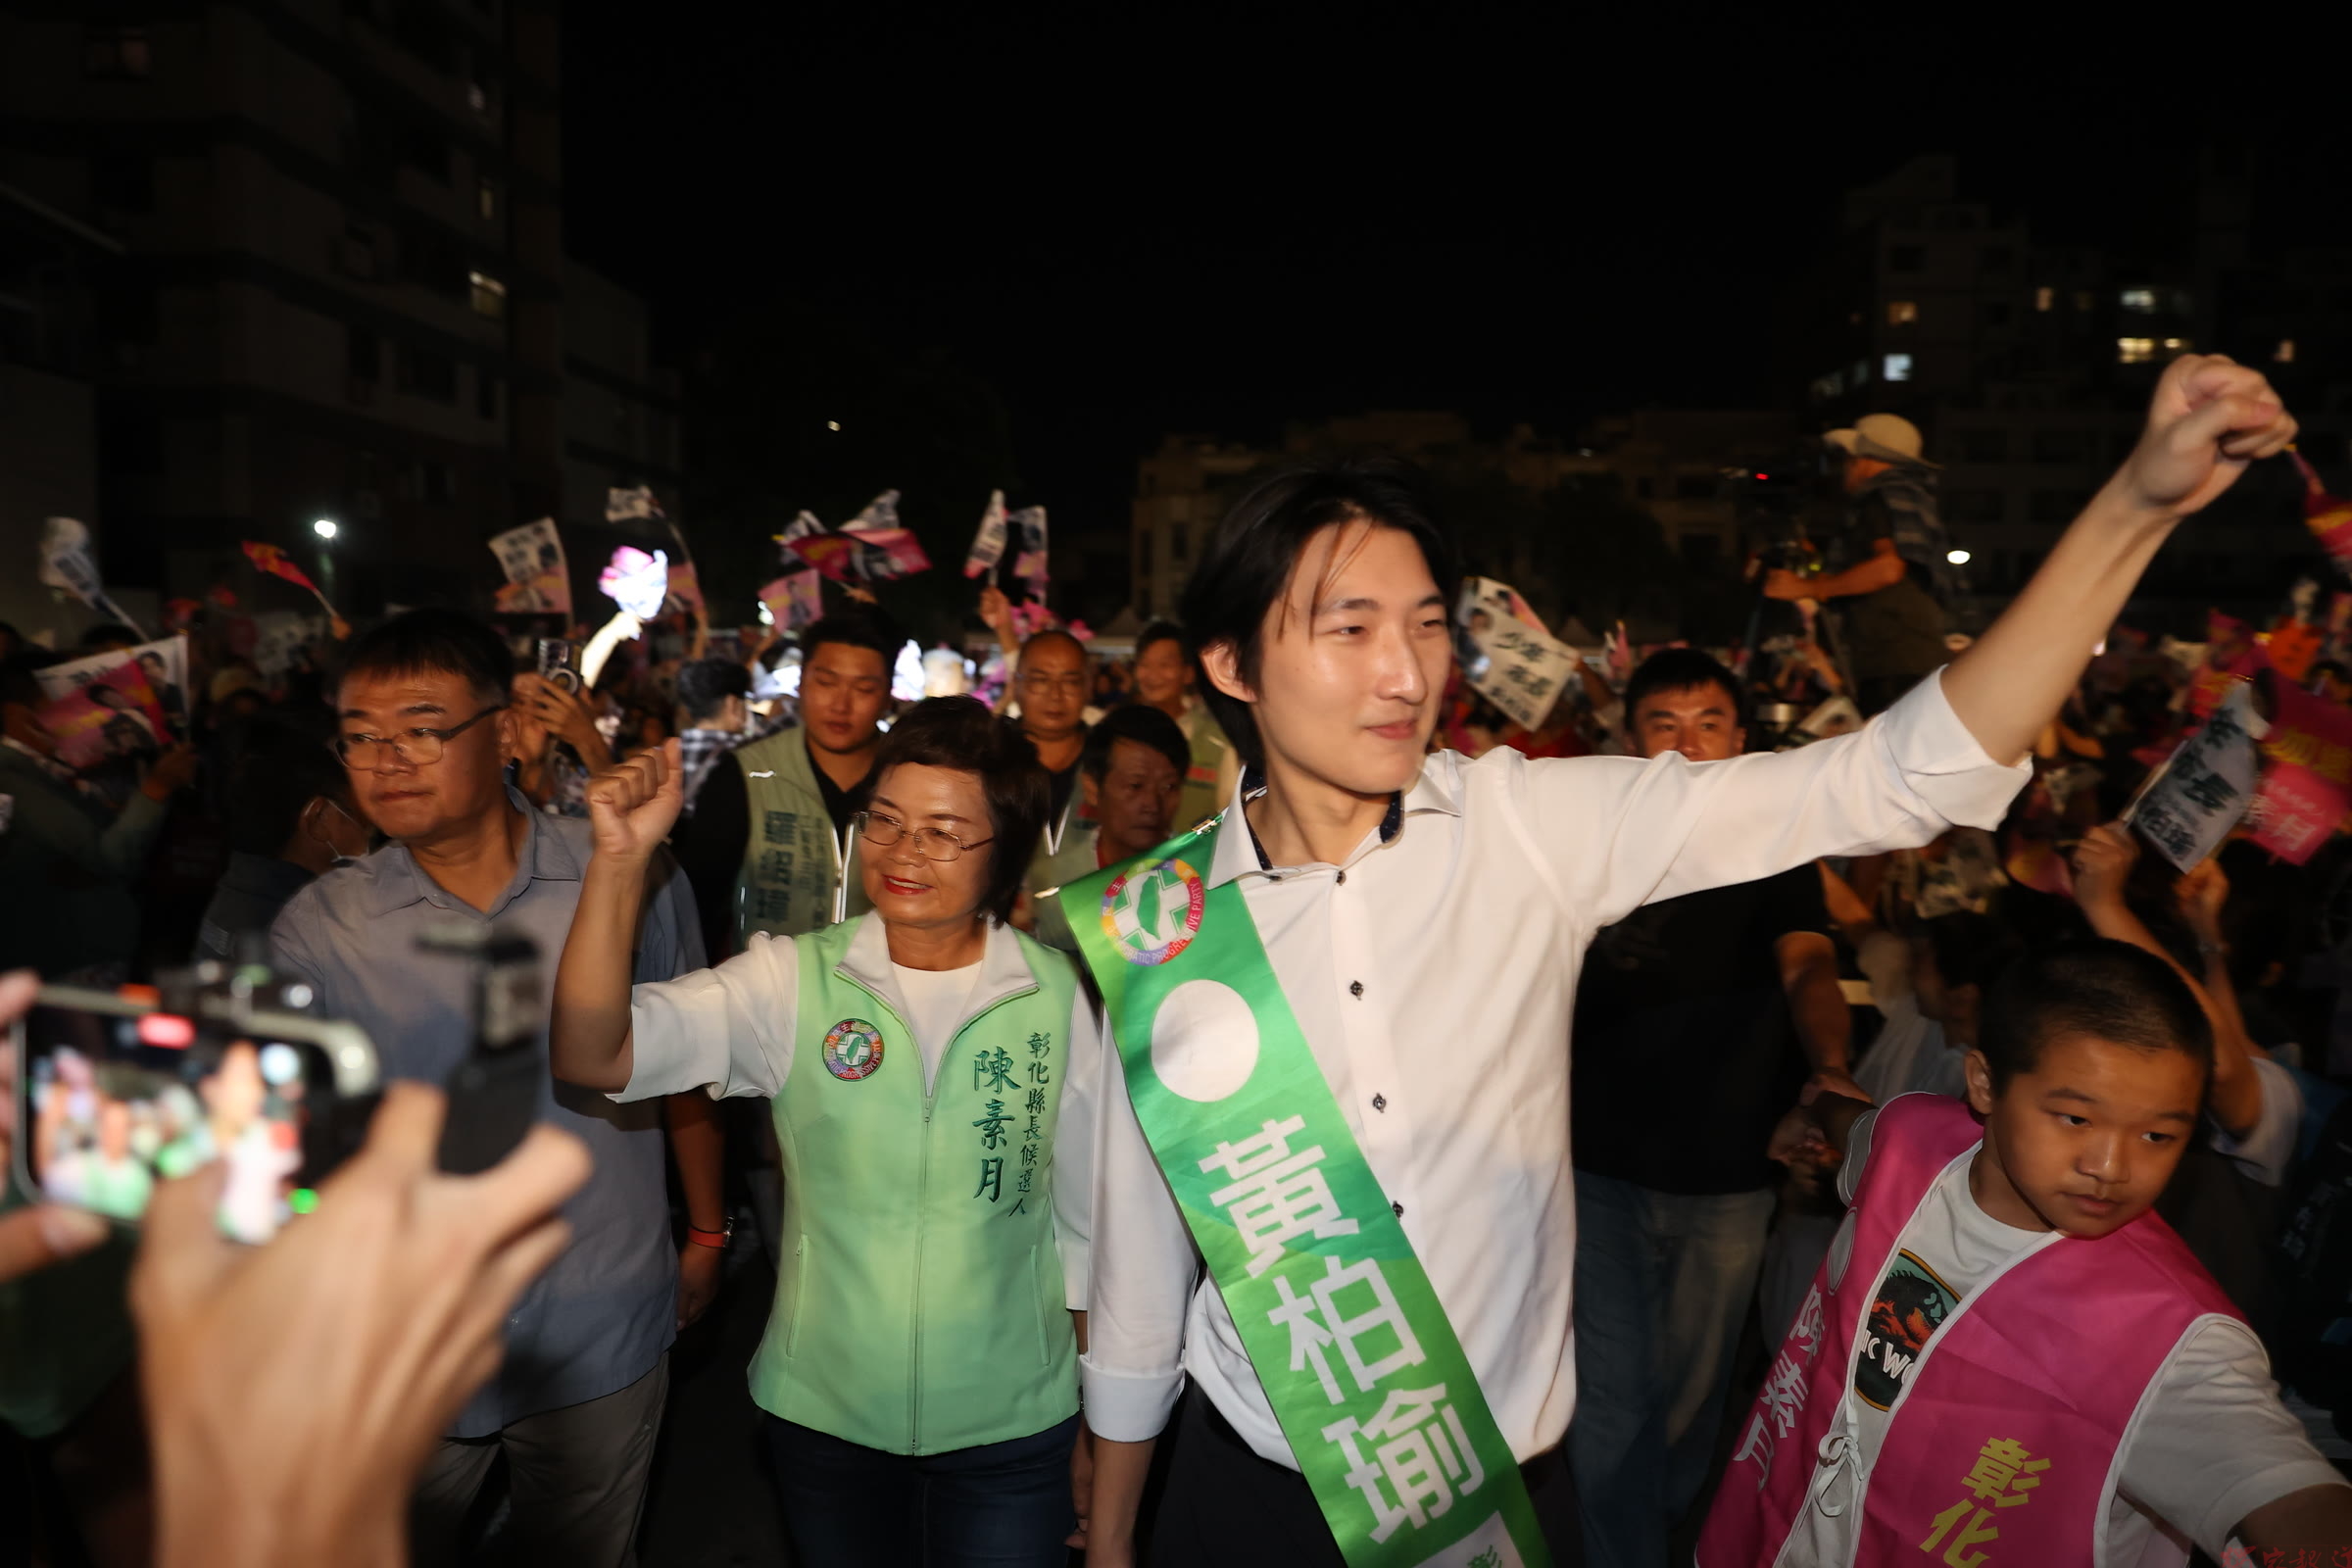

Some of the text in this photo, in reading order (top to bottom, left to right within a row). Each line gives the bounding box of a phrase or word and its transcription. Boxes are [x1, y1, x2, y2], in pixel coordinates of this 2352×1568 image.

[972, 1046, 1021, 1203] 陳素月
[1008, 1032, 1051, 1217] 彰化縣長候選人
[1198, 1114, 1485, 1544] 黃柏瑜
[1919, 1437, 2051, 1568] 彰化
